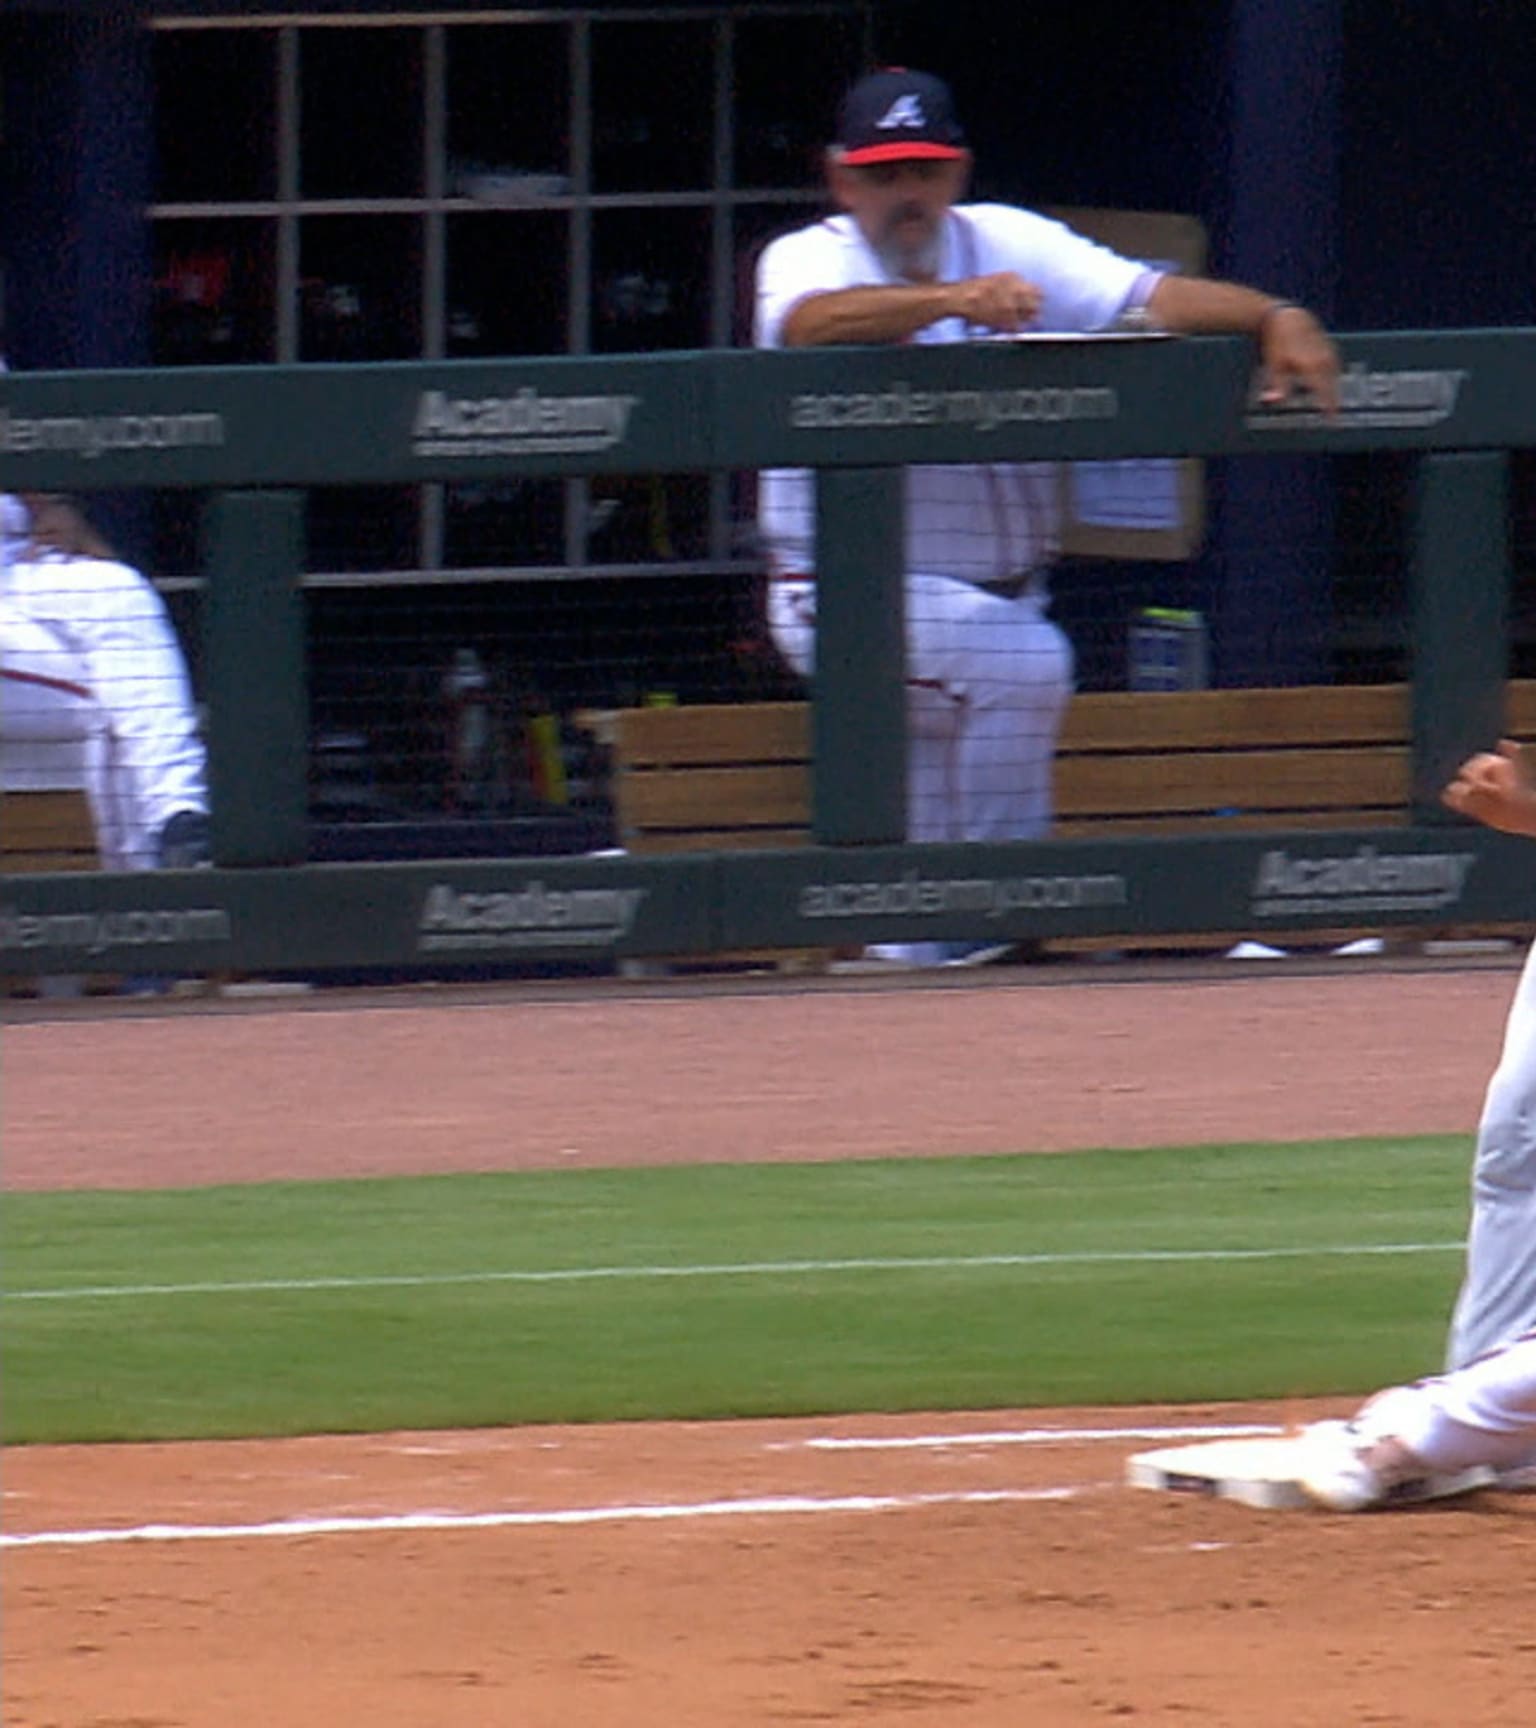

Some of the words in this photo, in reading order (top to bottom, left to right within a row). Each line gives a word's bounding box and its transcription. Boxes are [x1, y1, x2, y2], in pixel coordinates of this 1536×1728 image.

[876, 94, 925, 128] A
[411, 387, 640, 440] Academy
[793, 382, 1117, 430] academy.com
[801, 870, 1126, 919] academy.com
[1254, 846, 1476, 900] Academy
[420, 882, 648, 938] Academy
